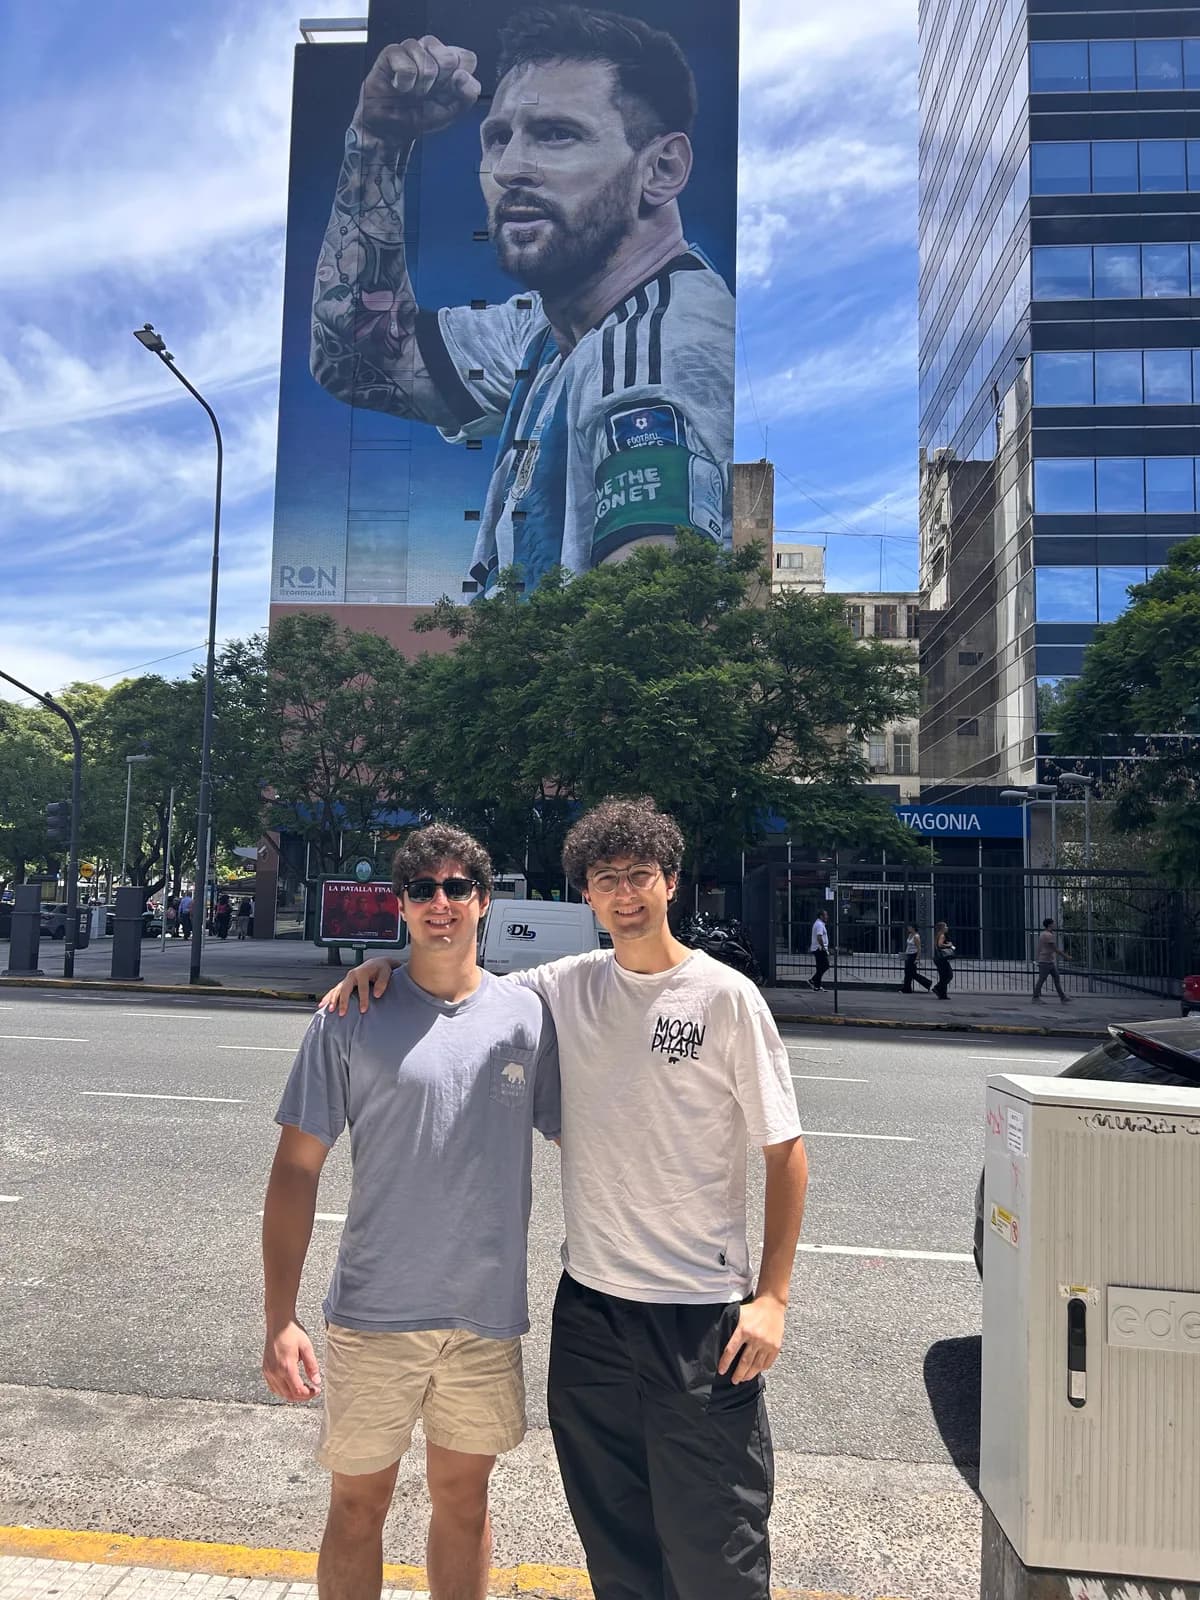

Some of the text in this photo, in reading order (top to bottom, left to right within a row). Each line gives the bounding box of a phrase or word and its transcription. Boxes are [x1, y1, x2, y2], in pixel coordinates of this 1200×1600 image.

[615, 467, 660, 487] THE
[279, 566, 337, 588] RON
[340, 885, 372, 893] BATALLA
[655, 1016, 706, 1046] MOON
[651, 1033, 699, 1060] PHASE
